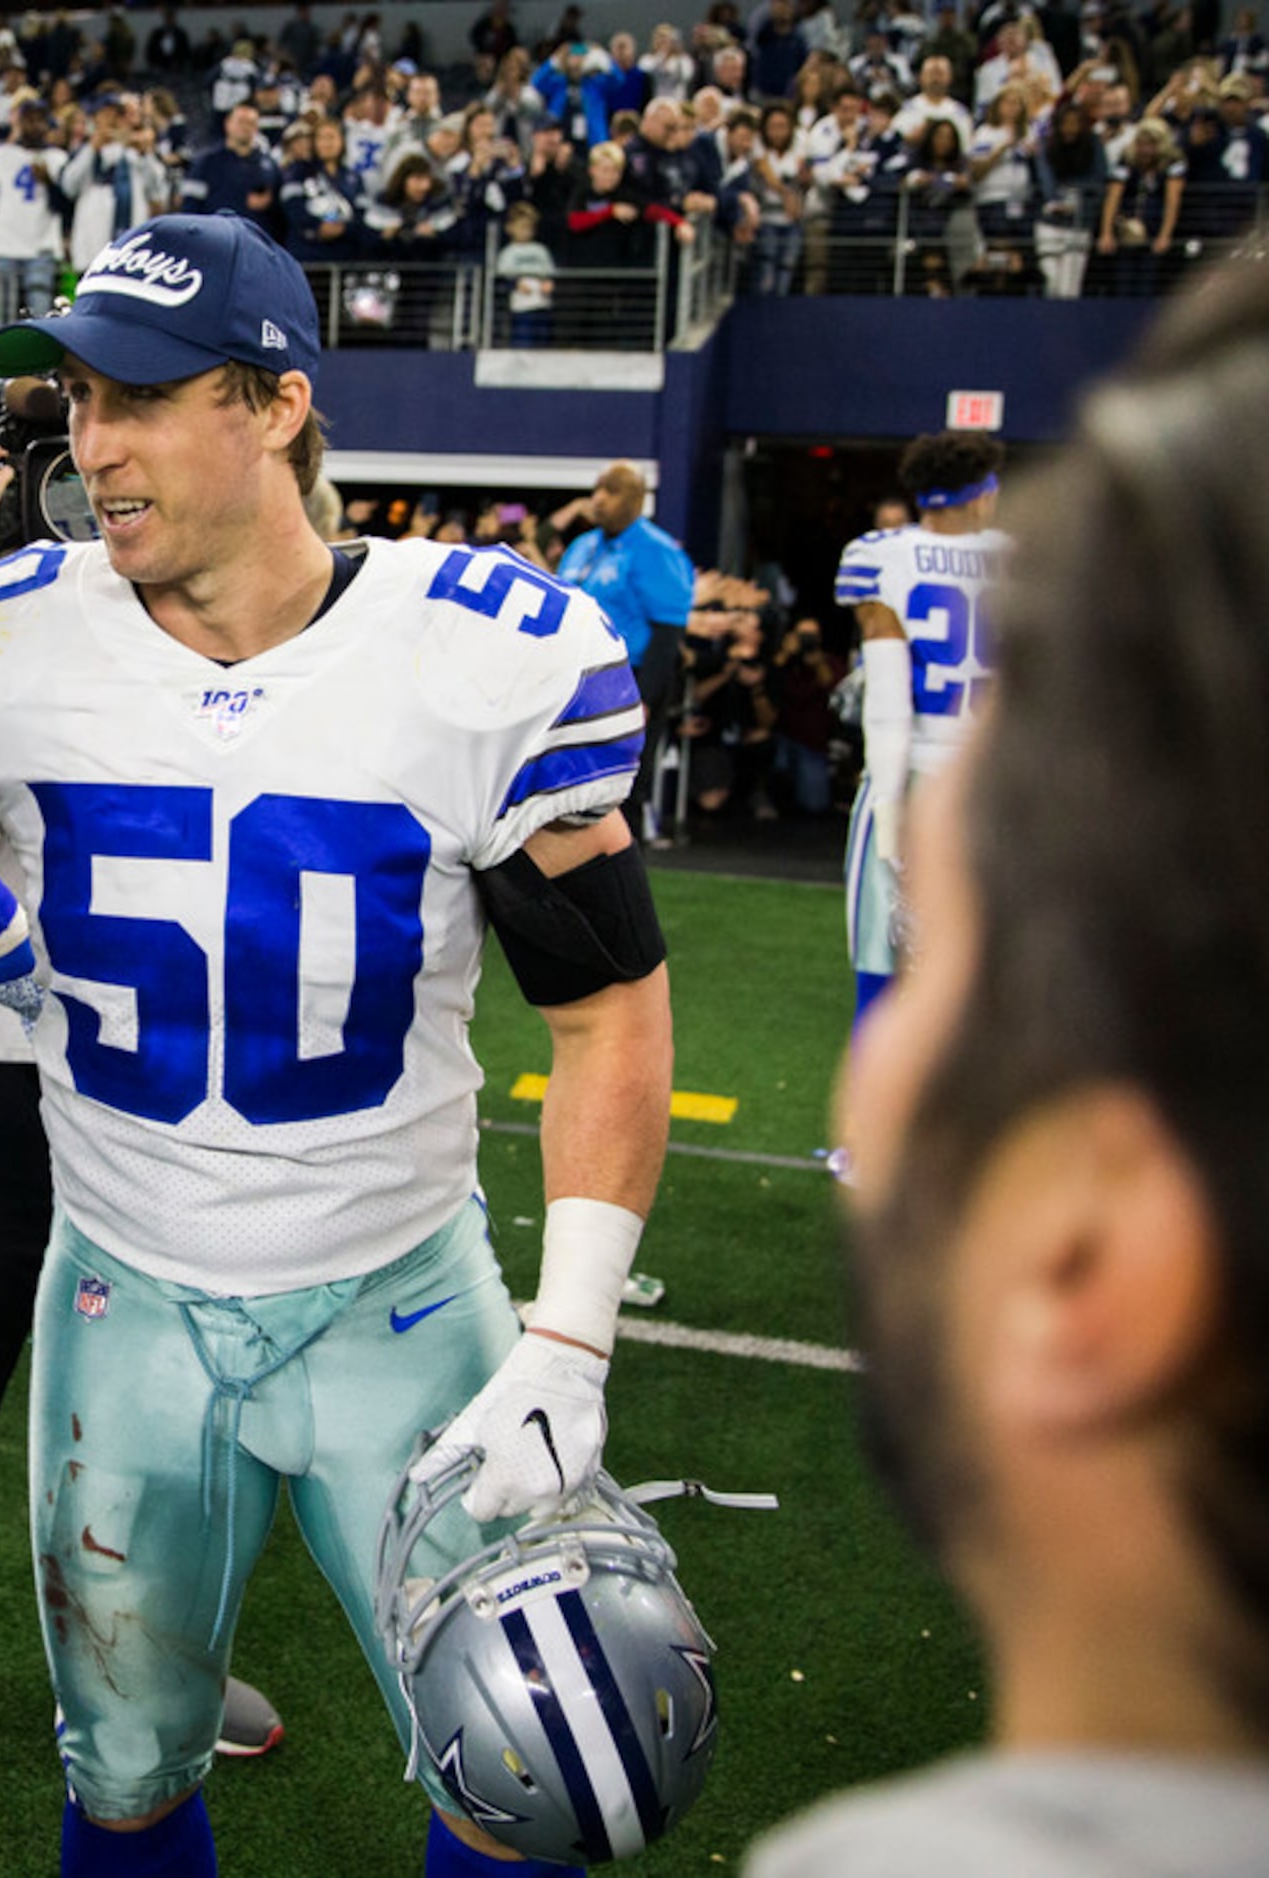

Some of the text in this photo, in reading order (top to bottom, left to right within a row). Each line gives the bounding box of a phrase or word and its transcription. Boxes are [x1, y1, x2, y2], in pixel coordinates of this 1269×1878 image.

[1221, 139, 1250, 179] 4
[26, 782, 432, 1126] 50
[496, 1569, 562, 1604] COWBOYS
